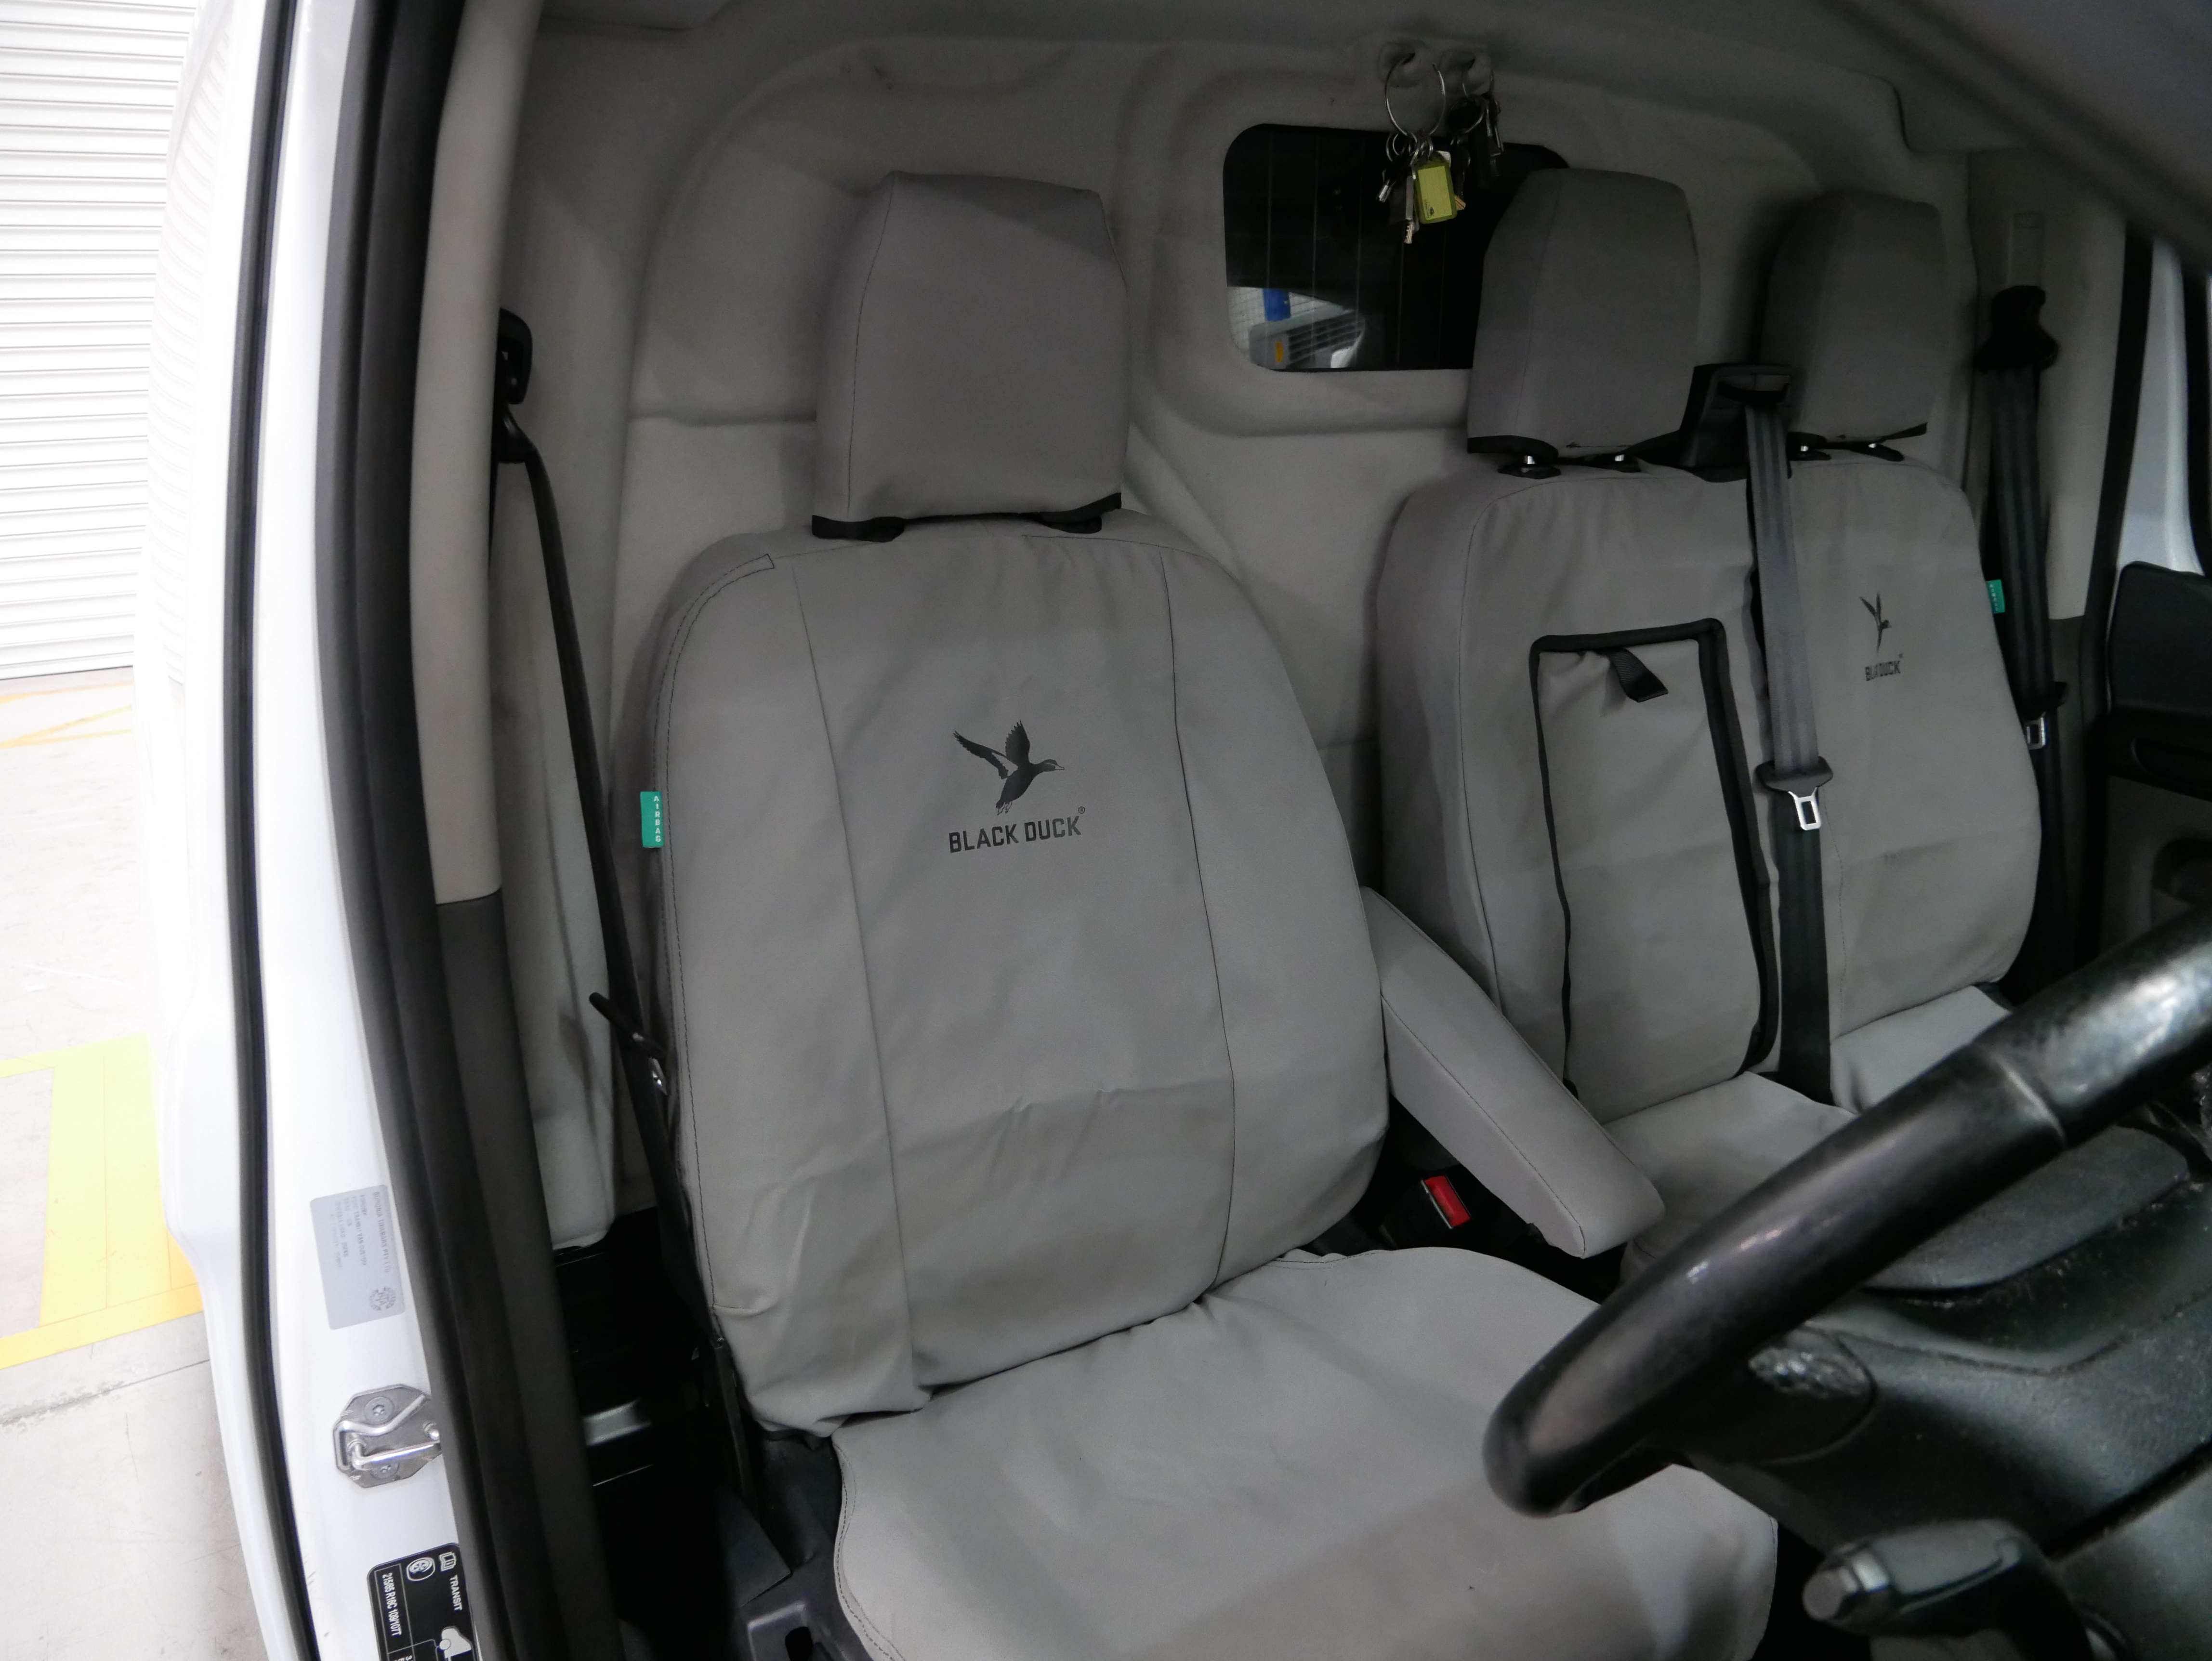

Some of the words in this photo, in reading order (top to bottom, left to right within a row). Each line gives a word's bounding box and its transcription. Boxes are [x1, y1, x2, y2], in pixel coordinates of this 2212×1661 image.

[949, 824, 1019, 853] BLACK
[1024, 816, 1081, 842] DUCK
[382, 1572, 395, 1592] 215/65
[449, 1574, 462, 1611] TRANSIT
[385, 1592, 397, 1609] R16C
[388, 1608, 401, 1636] 109/107T
